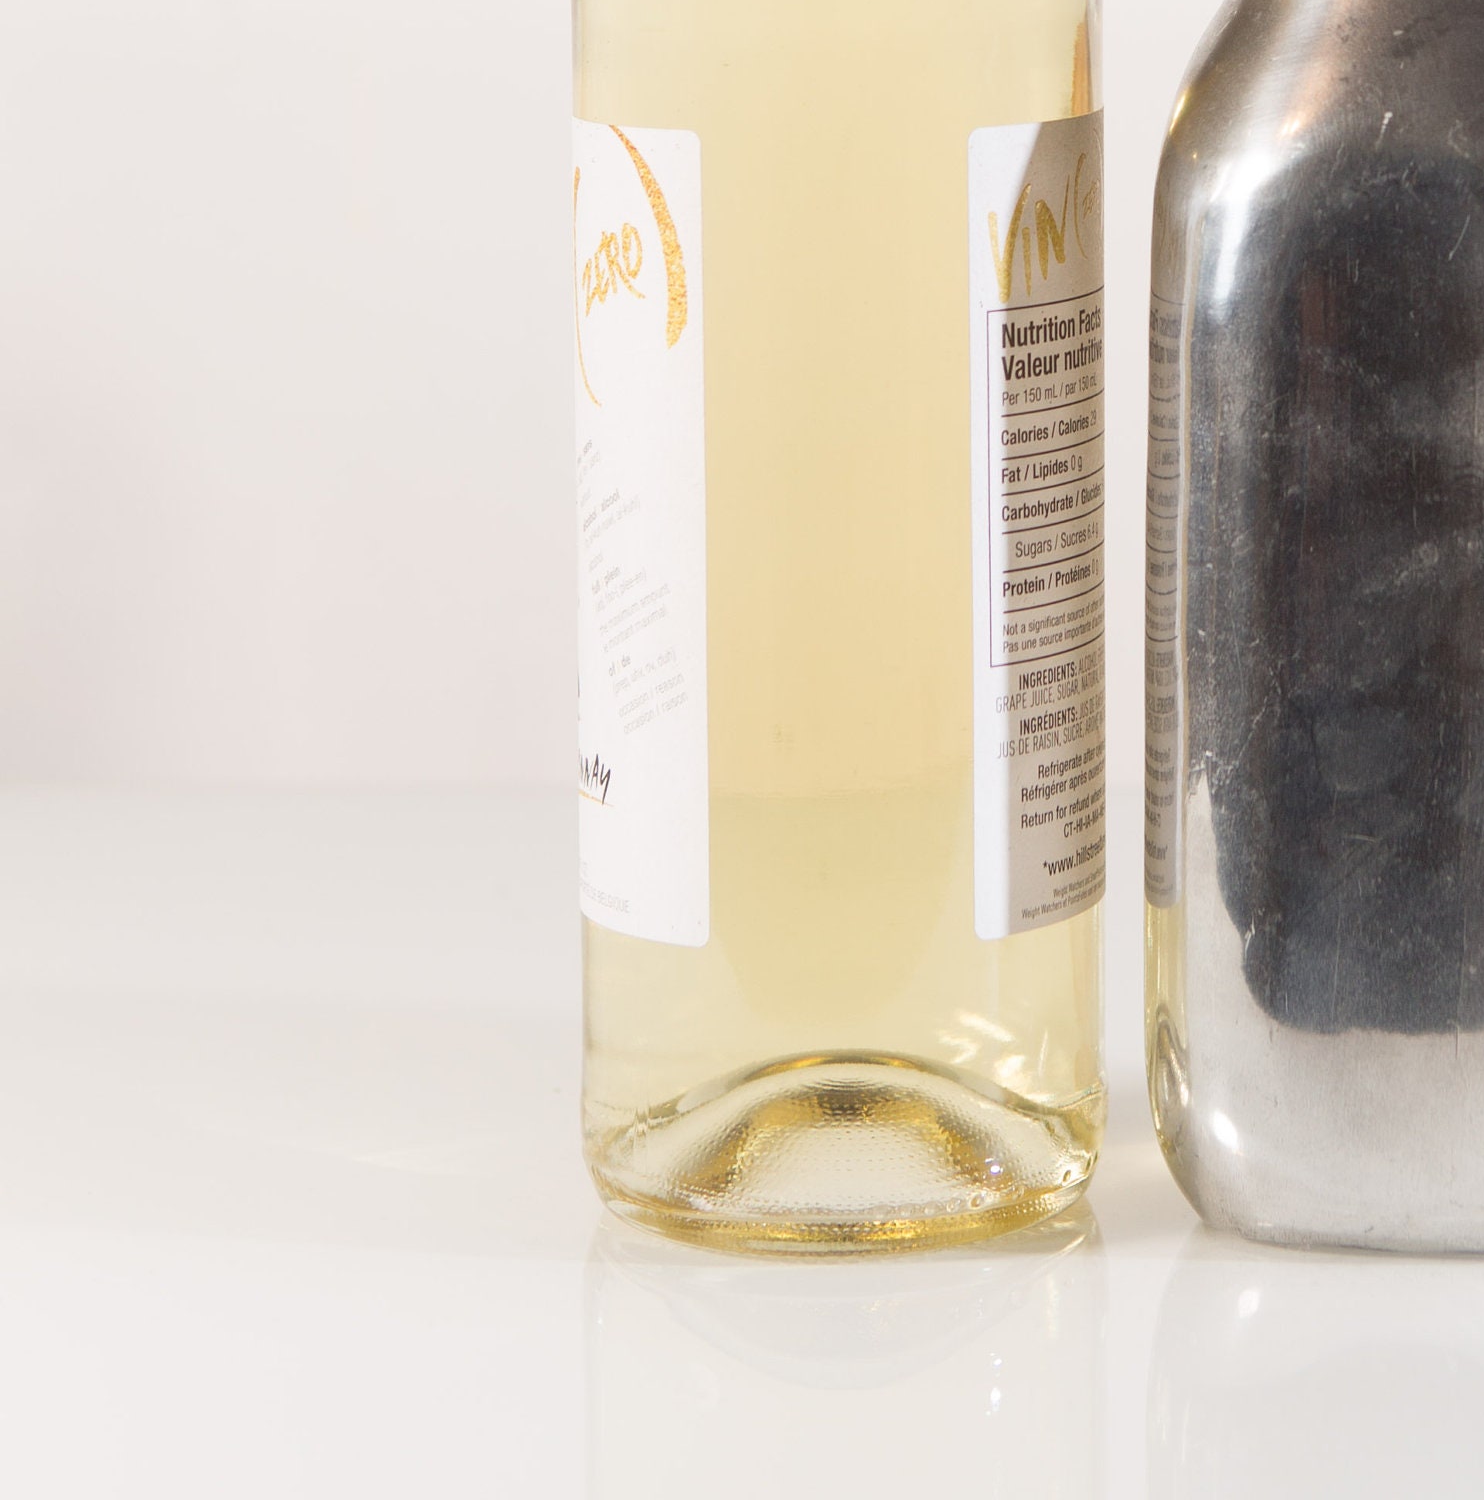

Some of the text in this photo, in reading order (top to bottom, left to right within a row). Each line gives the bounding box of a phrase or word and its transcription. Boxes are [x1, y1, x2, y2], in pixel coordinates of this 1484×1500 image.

[1001, 305, 1102, 349] Nutrition Facts
[1001, 352, 1059, 381] Valeur
[1002, 391, 1019, 406] Per
[1023, 386, 1042, 402] 150
[1044, 384, 1058, 399] mL
[1065, 381, 1077, 395] par
[1001, 425, 1049, 446] Calories
[1058, 414, 1089, 436] Calories
[1002, 466, 1021, 484] Fat
[1033, 458, 1069, 480] Lipides
[1002, 495, 1074, 522] Carbohydrate
[1015, 539, 1052, 559] Sugars
[1060, 527, 1087, 548] Sucres
[1003, 576, 1045, 597] Protein
[1055, 564, 1091, 588] Protéines
[1003, 623, 1018, 636] Not
[1020, 622, 1026, 634] a
[1028, 614, 1066, 633] significant
[1003, 640, 1019, 653] Pas
[1021, 638, 1037, 650] une
[1039, 632, 1063, 646] source
[1019, 661, 1077, 690] INGREDIENTS:
[996, 693, 1027, 714] GRAPE
[1019, 706, 1078, 736] INGRÉDIENTS:
[996, 740, 1015, 760] JUS
[1018, 737, 1030, 755] DE
[1038, 757, 1082, 780] Refrigerate
[1021, 779, 1067, 803] Réfrigérer
[1069, 771, 1087, 790] après
[1021, 810, 1053, 829] Return
[1056, 804, 1068, 819] for
[1069, 797, 1090, 816] refund
